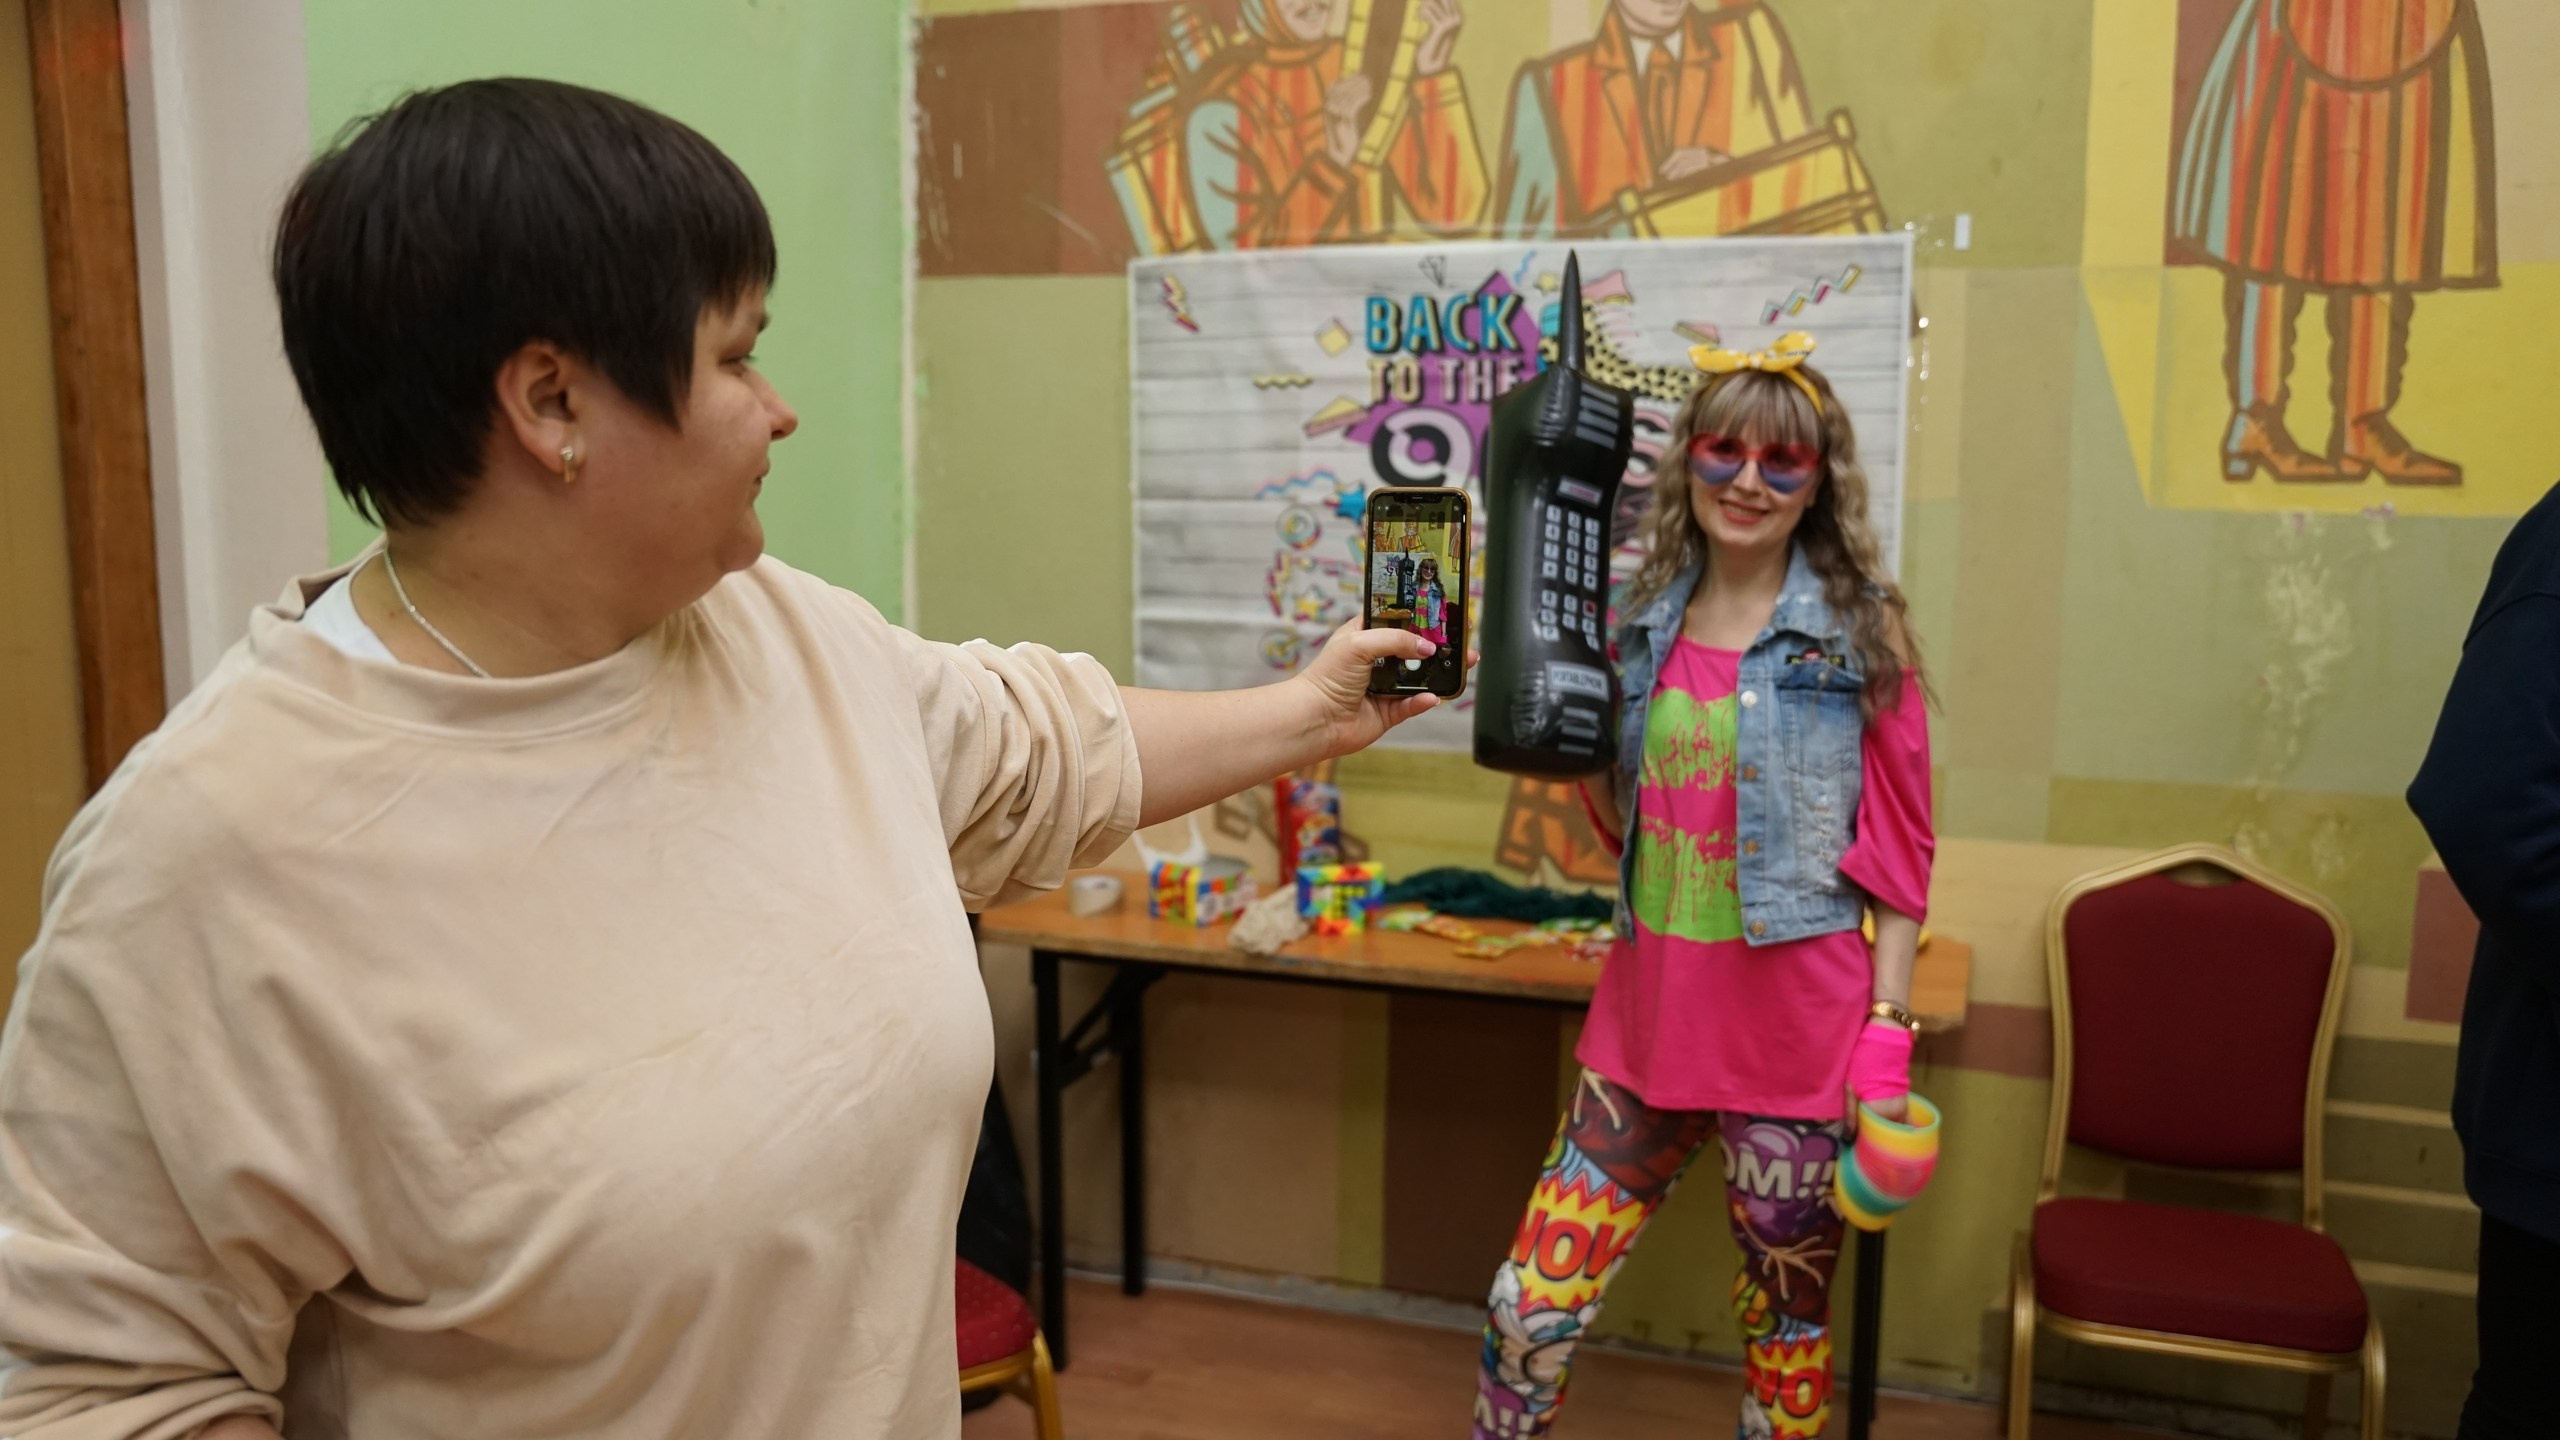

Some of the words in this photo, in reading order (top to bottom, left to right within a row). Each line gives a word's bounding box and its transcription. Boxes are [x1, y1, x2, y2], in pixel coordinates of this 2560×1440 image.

[1366, 294, 1523, 355] BACK
[1369, 358, 1423, 404] TO
[1440, 358, 1525, 403] THE
